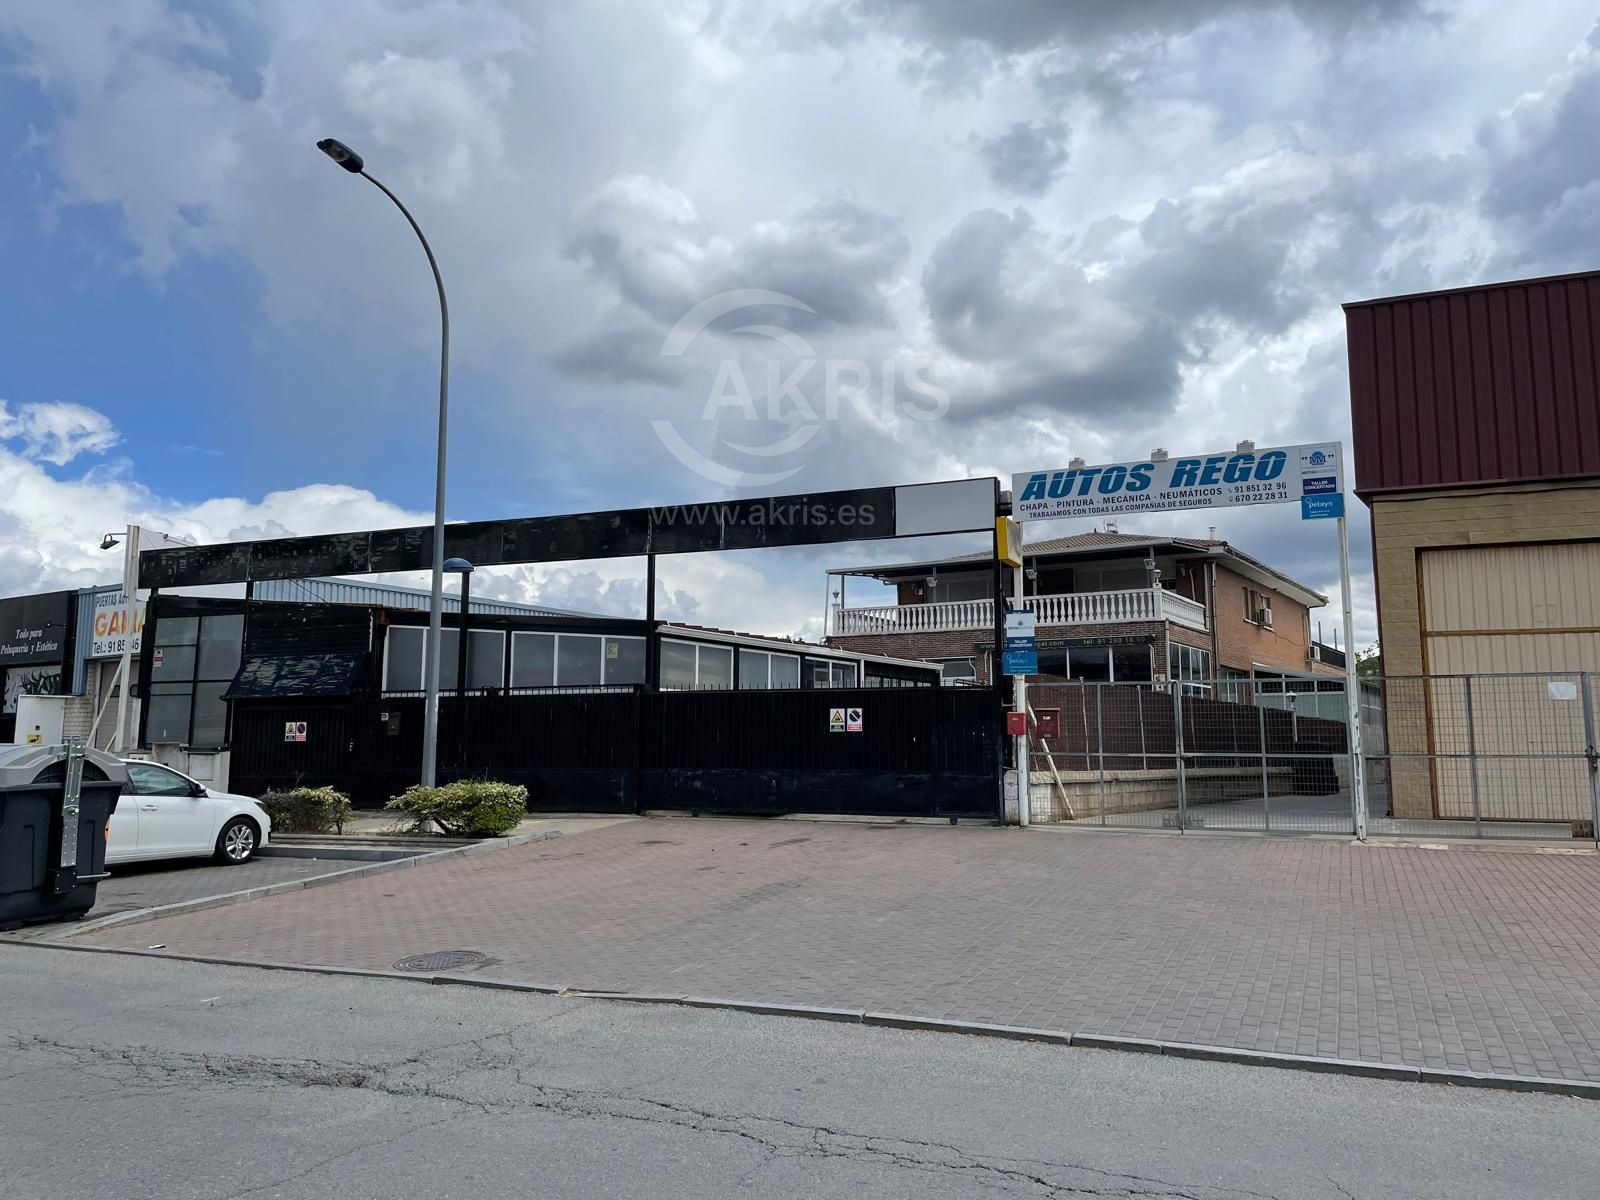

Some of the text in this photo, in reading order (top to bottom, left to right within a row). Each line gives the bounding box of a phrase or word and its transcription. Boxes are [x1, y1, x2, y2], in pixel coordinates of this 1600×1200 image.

[1019, 450, 1287, 501] AUTOS REGO
[1234, 482, 1287, 493] 91 851 32 96
[1019, 502, 1049, 512] CHAPA
[1056, 499, 1094, 509] PINTURA
[1102, 493, 1151, 505] MECÁNICA
[1160, 487, 1222, 499] NEUMÁTICOS
[1235, 490, 1288, 502] 670 22 28 31
[1029, 508, 1071, 519] TRABAJAMOS
[1072, 507, 1087, 516] CON
[1088, 505, 1110, 514] TODAS
[1111, 504, 1124, 512] LAS
[1167, 500, 1177, 508] DE
[1178, 497, 1213, 508] SEGUROS
[96, 593, 118, 607] PUERTAS
[107, 641, 116, 653] 91
